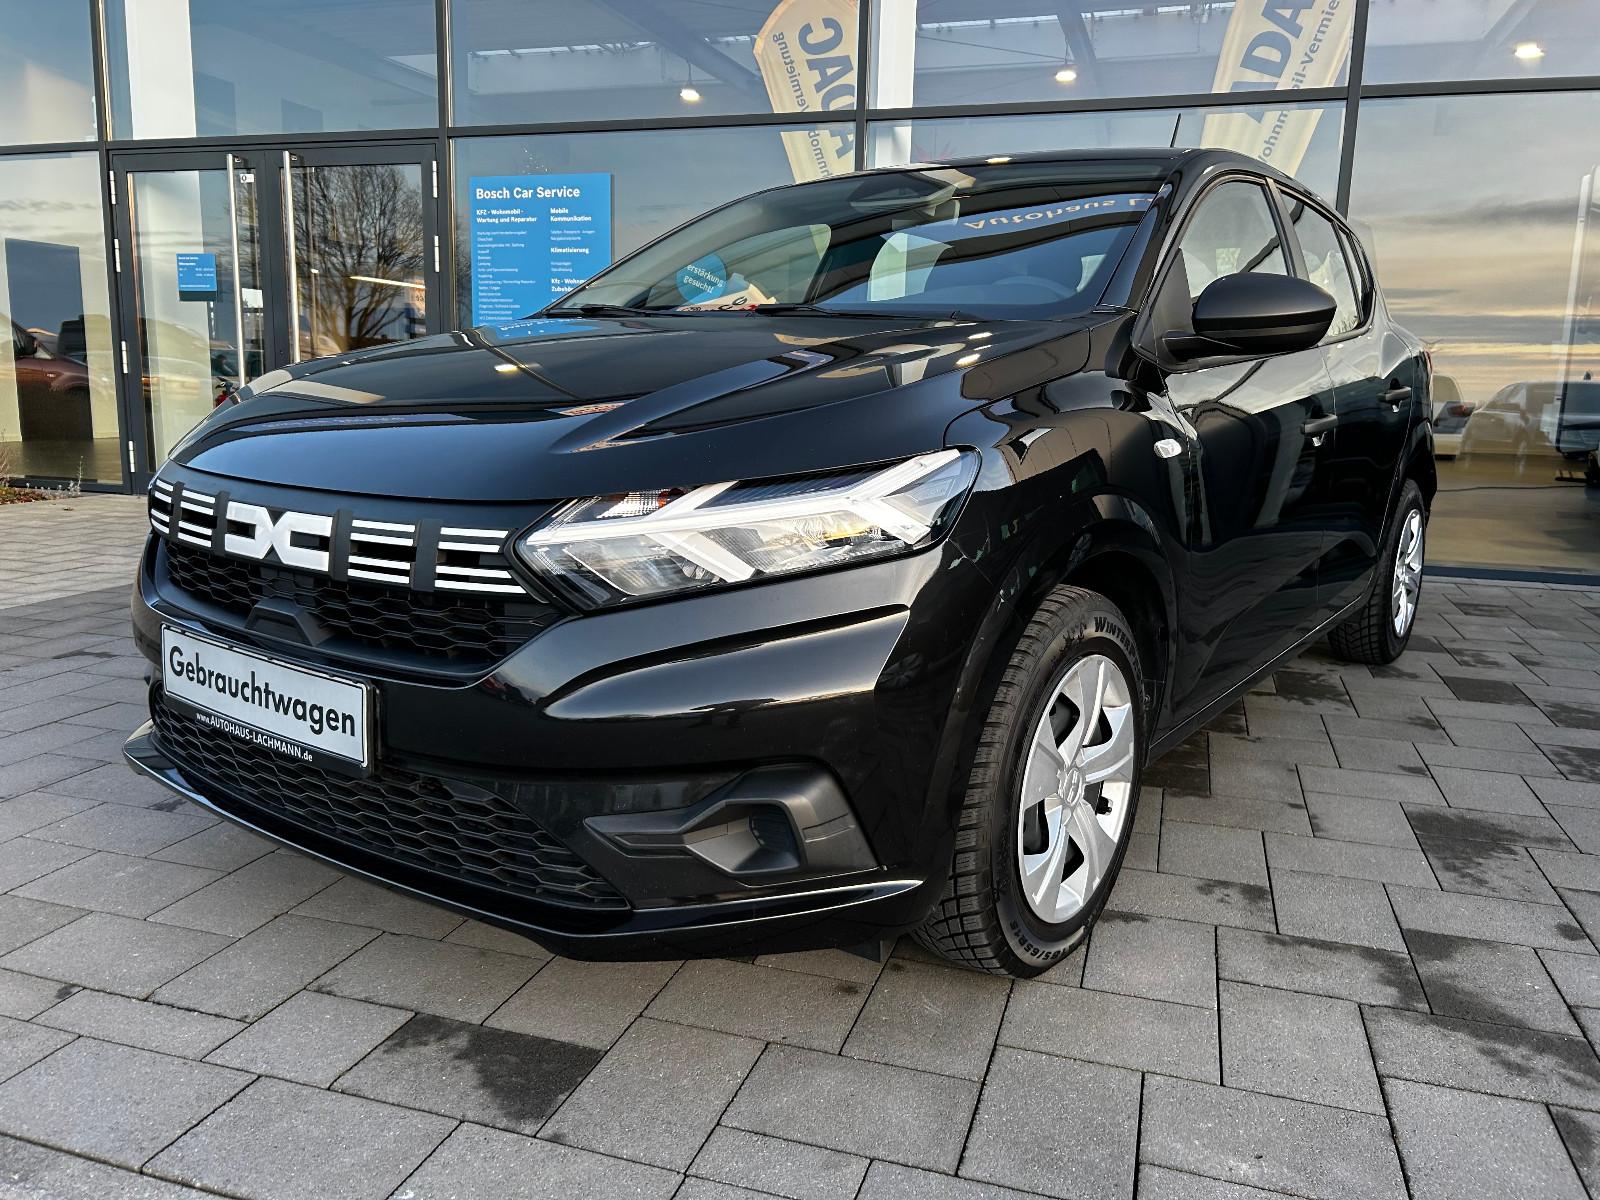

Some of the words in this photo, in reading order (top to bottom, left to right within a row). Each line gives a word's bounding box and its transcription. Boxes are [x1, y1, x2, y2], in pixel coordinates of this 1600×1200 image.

[476, 187, 510, 200] Bosch
[513, 187, 534, 199] Car
[536, 186, 581, 198] Service
[169, 645, 356, 737] Gebrauchtwagen
[196, 712, 314, 762] www.AUTOHAUS-LACHMANN.de
